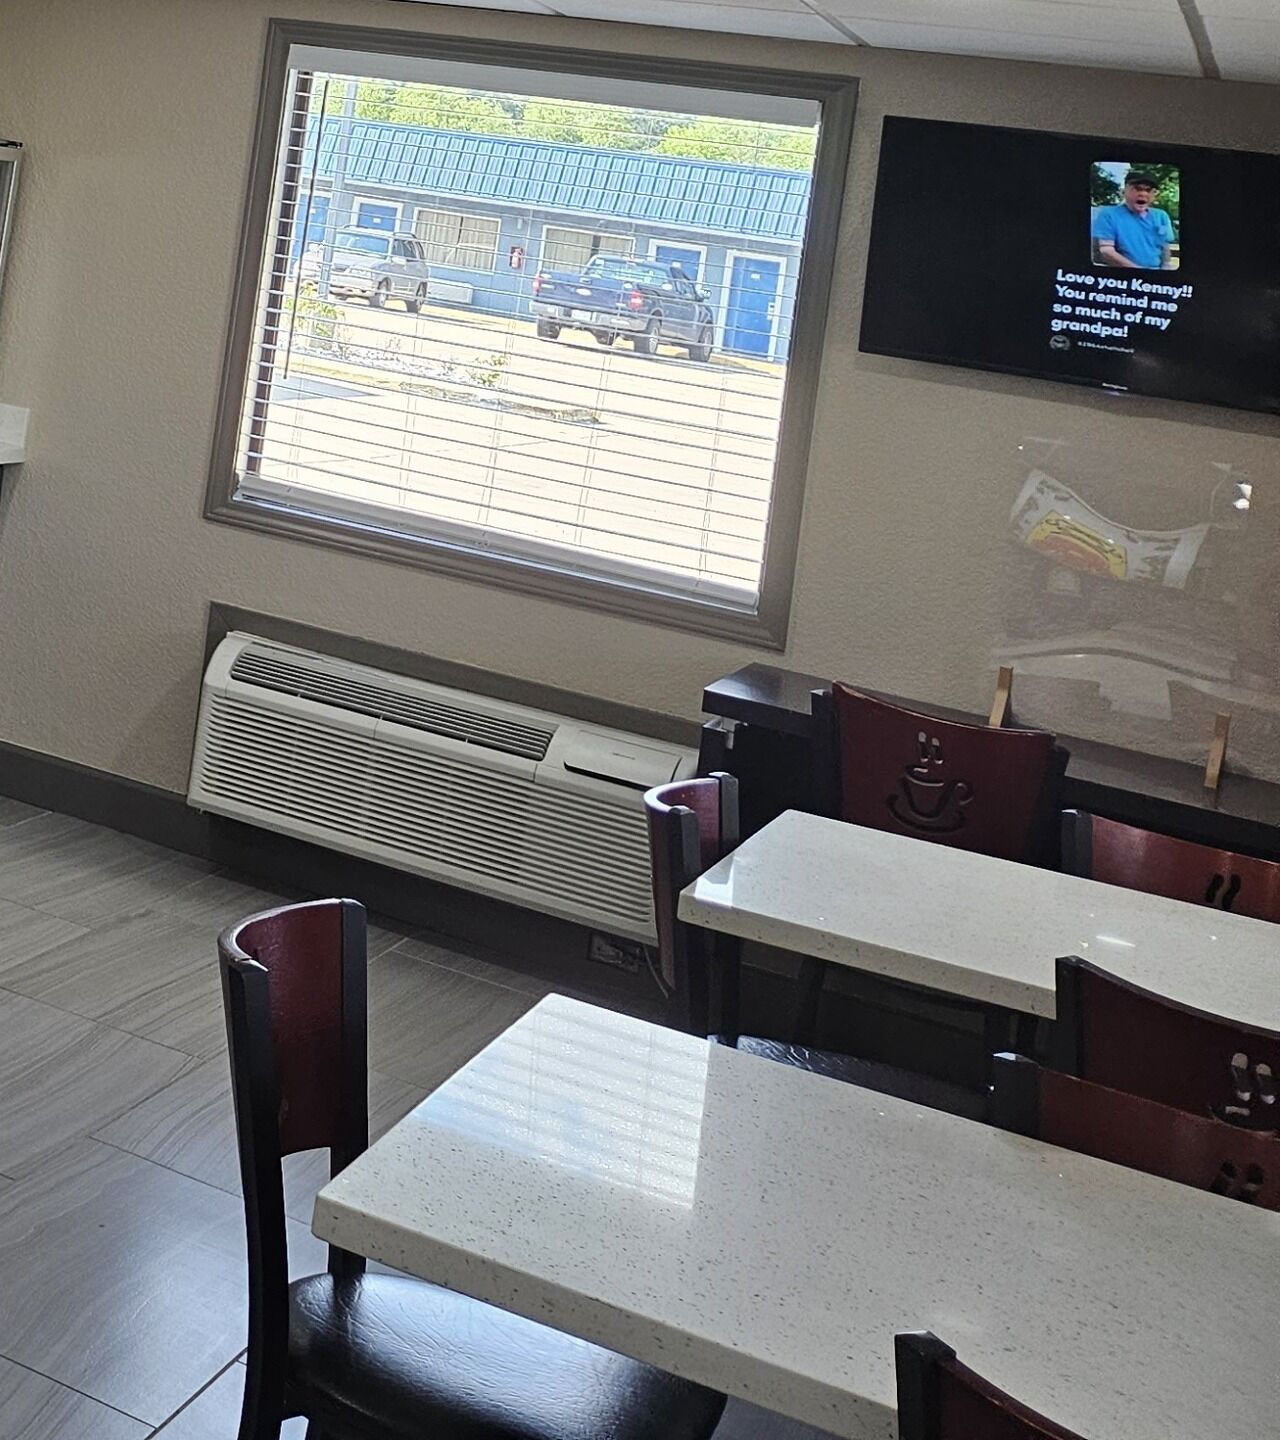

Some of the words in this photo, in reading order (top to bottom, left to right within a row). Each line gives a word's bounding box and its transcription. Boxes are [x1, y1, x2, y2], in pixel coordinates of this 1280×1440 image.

[1055, 284, 1086, 300] You
[1088, 292, 1148, 309] remind
[1150, 301, 1178, 312] me
[1056, 269, 1095, 285] Love
[1097, 277, 1128, 290] you
[1130, 278, 1193, 300] Kenny!!
[1050, 318, 1129, 338] grandpa!
[1052, 303, 1072, 313] so
[1075, 305, 1121, 320] much
[1123, 311, 1144, 324] of
[1144, 316, 1172, 331] my
